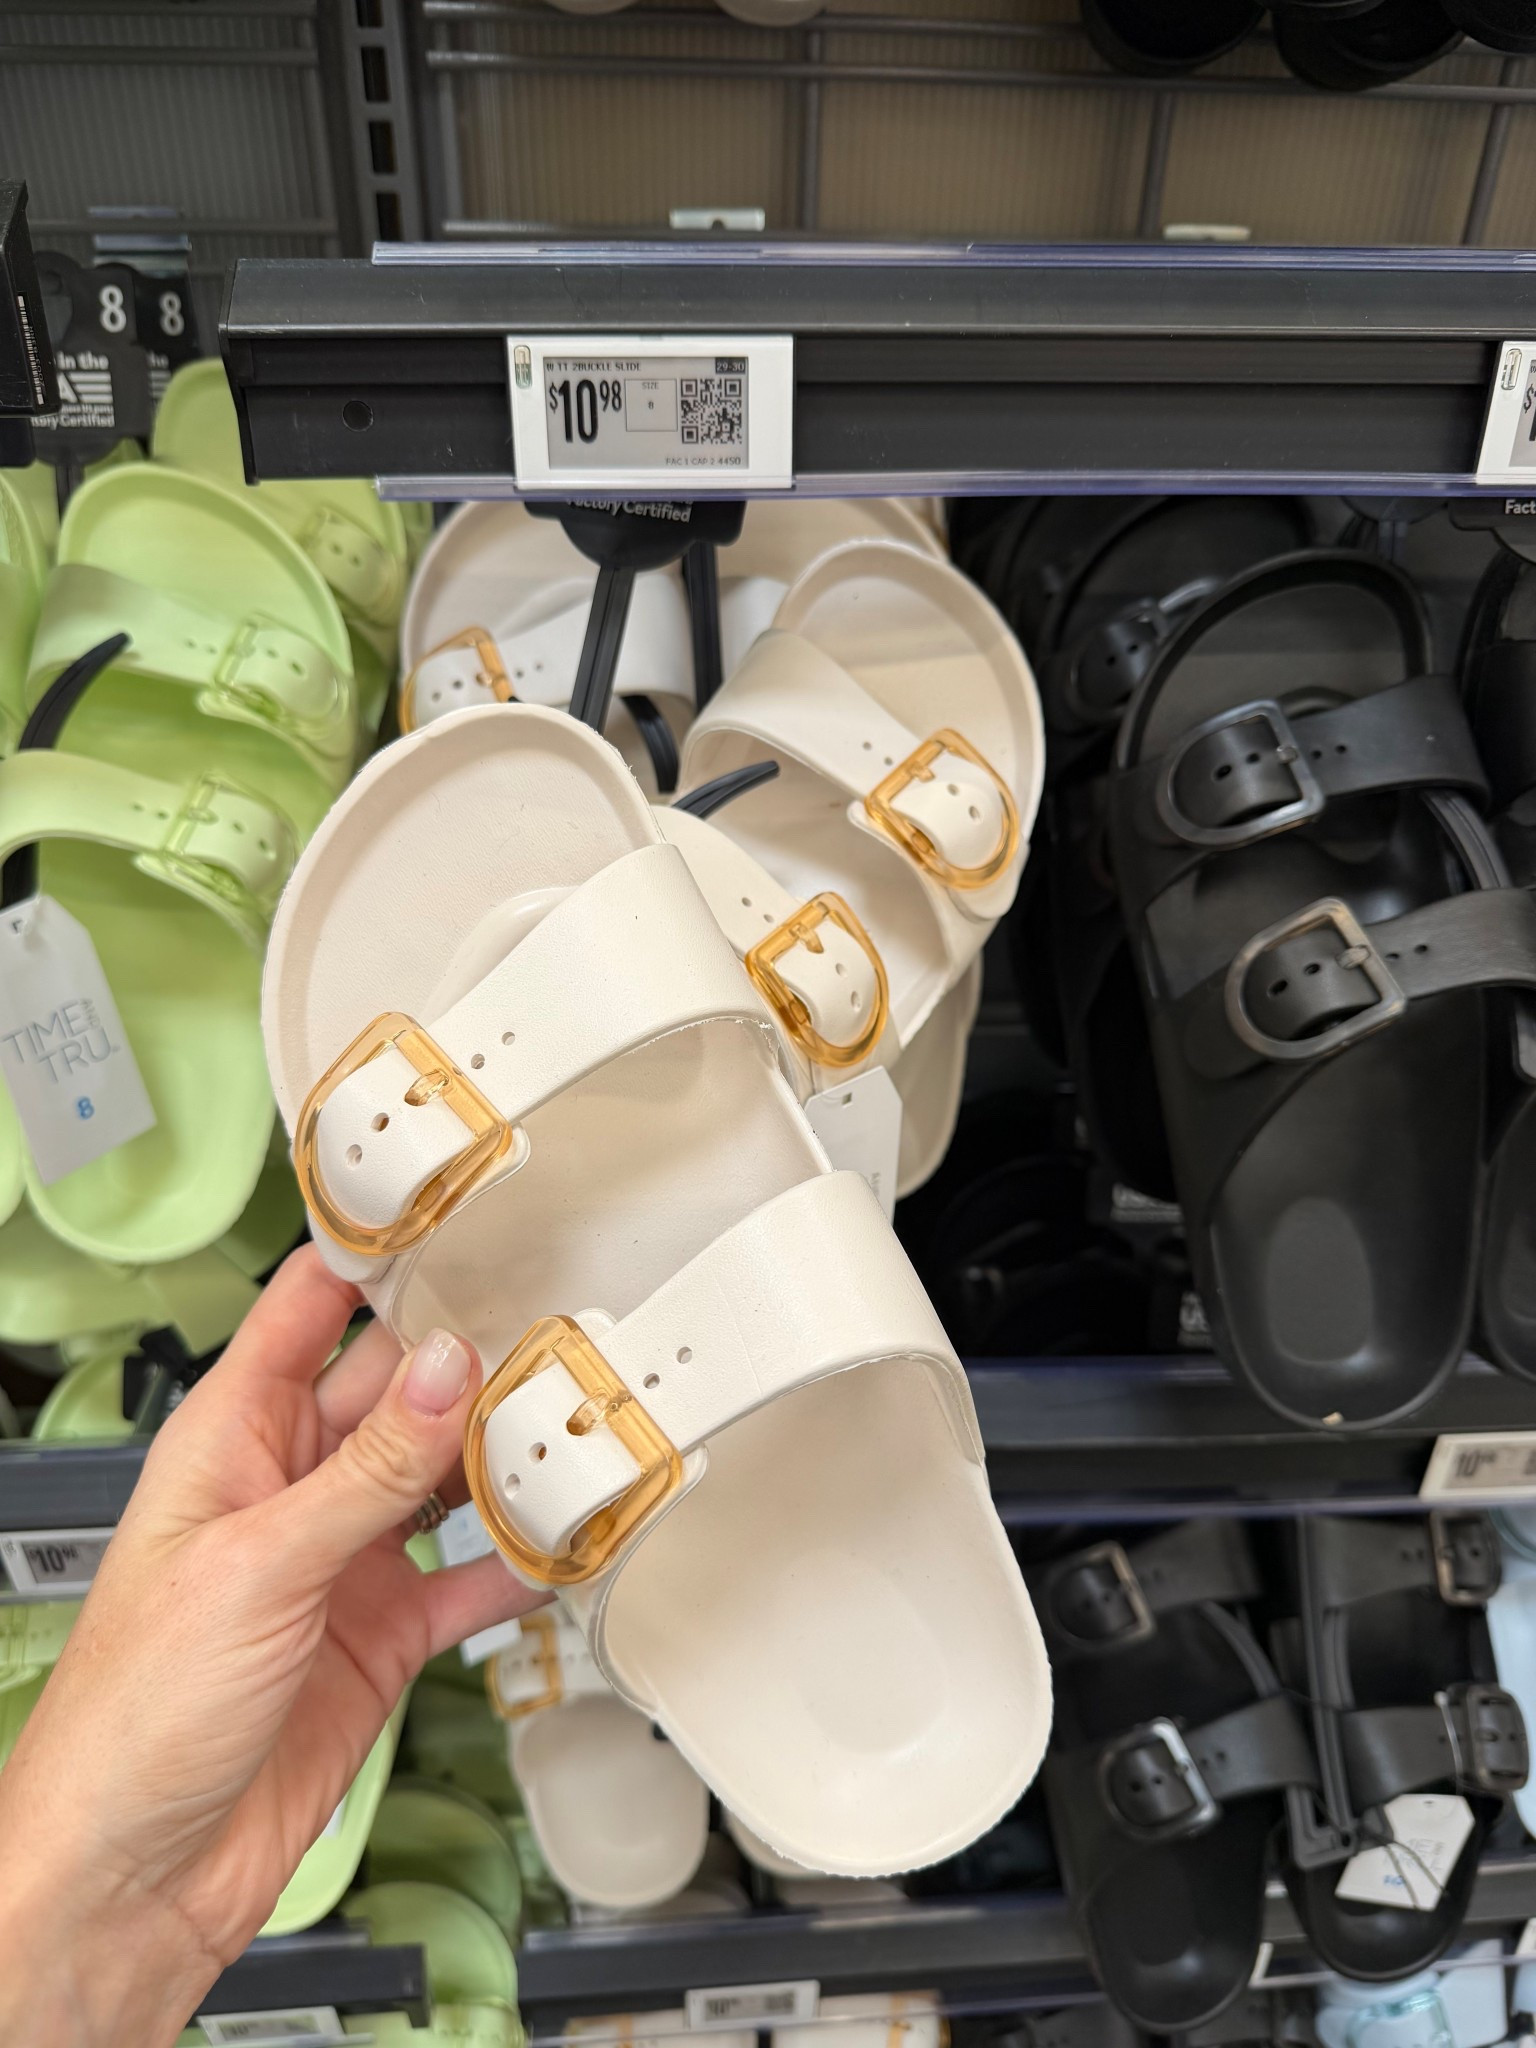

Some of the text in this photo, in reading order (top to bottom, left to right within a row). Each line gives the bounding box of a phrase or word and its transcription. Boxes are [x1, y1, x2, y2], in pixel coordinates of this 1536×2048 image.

[99, 285, 127, 333] 8
[160, 292, 185, 336] 8
[77, 350, 109, 370] the
[615, 362, 641, 372] SLIDE
[716, 361, 745, 372] 29-30
[641, 381, 659, 390] SIZE
[59, 413, 115, 427] Certified
[623, 499, 692, 523] Certified
[0, 1000, 88, 1064] TIME
[77, 1096, 95, 1120] 8
